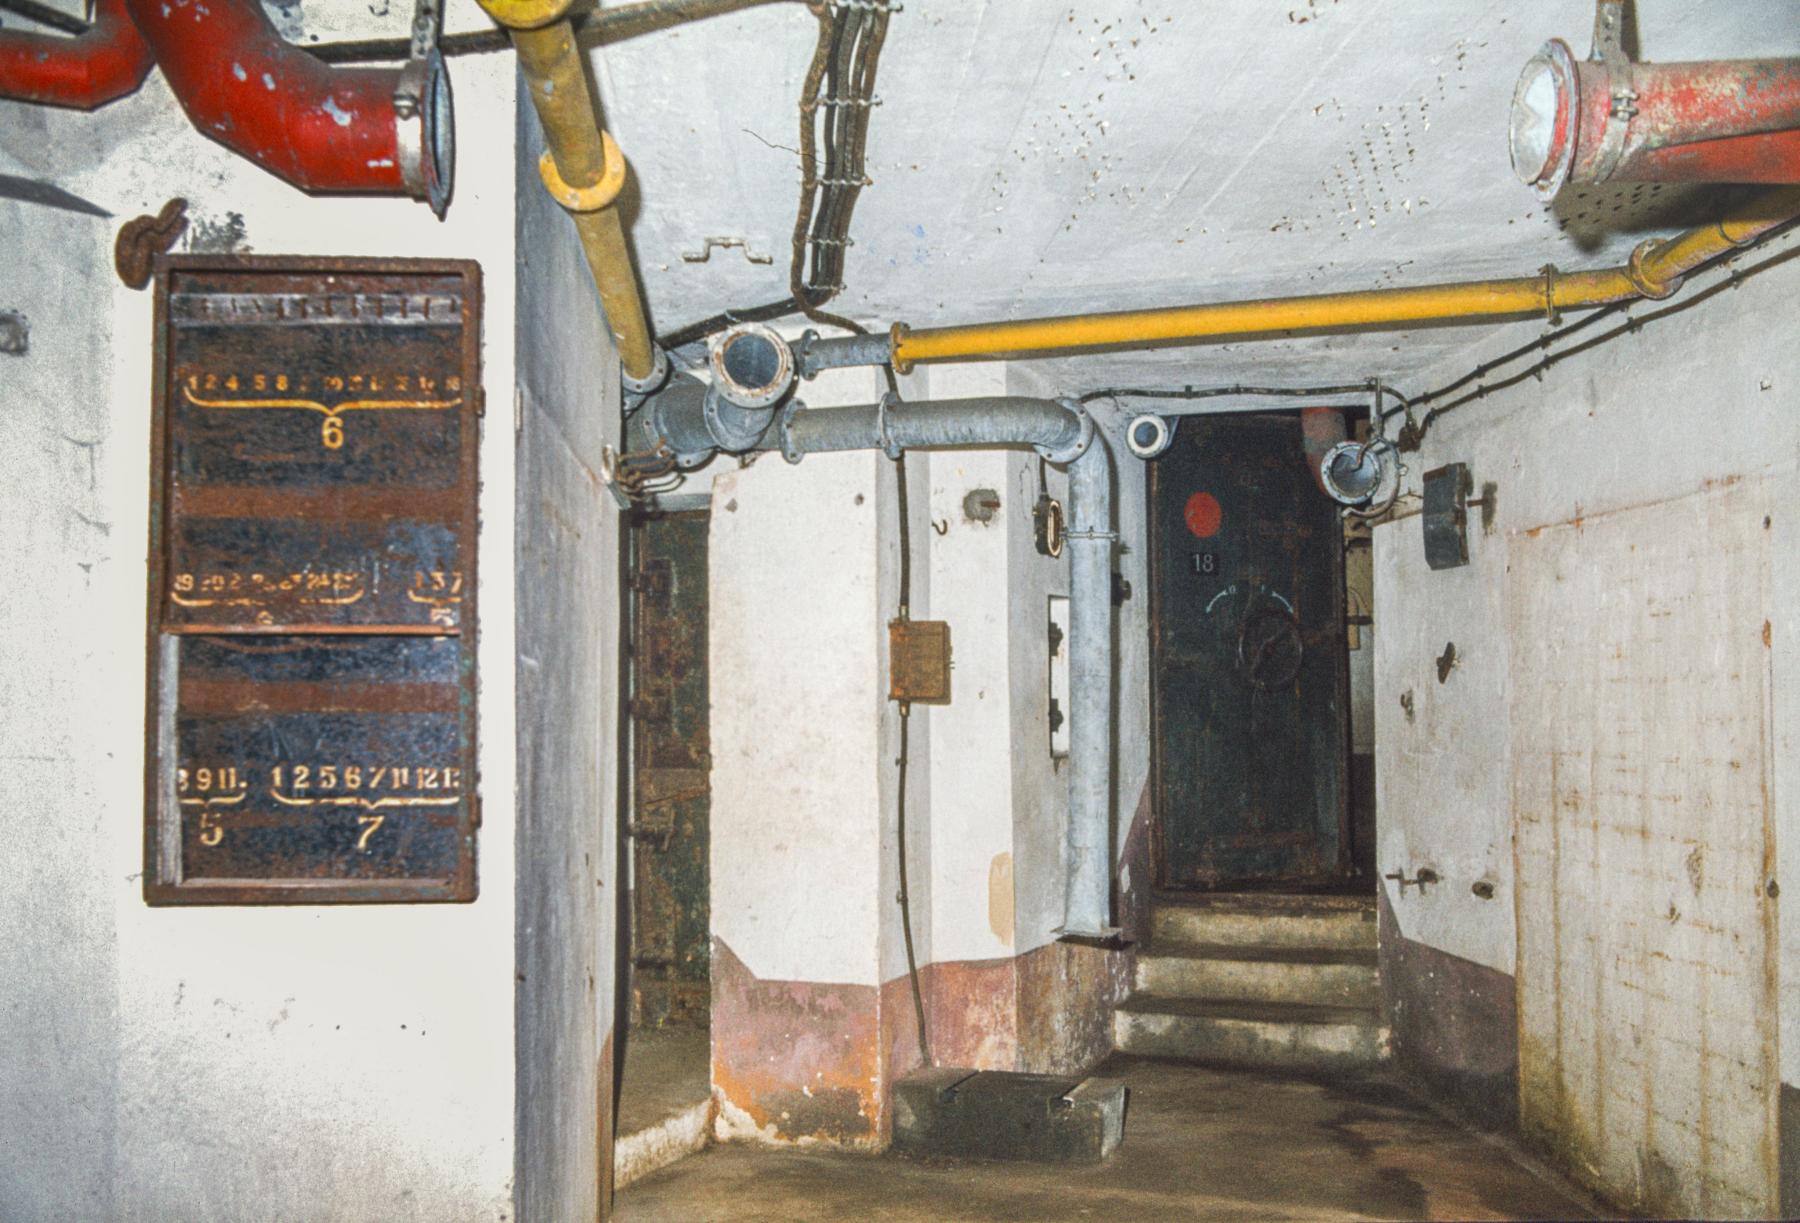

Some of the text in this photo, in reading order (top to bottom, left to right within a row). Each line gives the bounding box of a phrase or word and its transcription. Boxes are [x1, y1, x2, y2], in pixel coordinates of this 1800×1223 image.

[188, 375, 198, 391] 1
[205, 375, 217, 391] 2
[225, 375, 239, 391] 4
[254, 375, 267, 391] 5
[321, 416, 345, 449] 6
[1193, 553, 1214, 573] 18
[196, 767, 213, 792] 9
[271, 766, 283, 789] 1
[293, 765, 310, 789] 2
[319, 765, 338, 789] 5
[344, 765, 362, 790] 6
[369, 766, 386, 790] 7
[416, 767, 439, 790] 12
[200, 812, 224, 846] 5
[357, 815, 385, 849] 7
